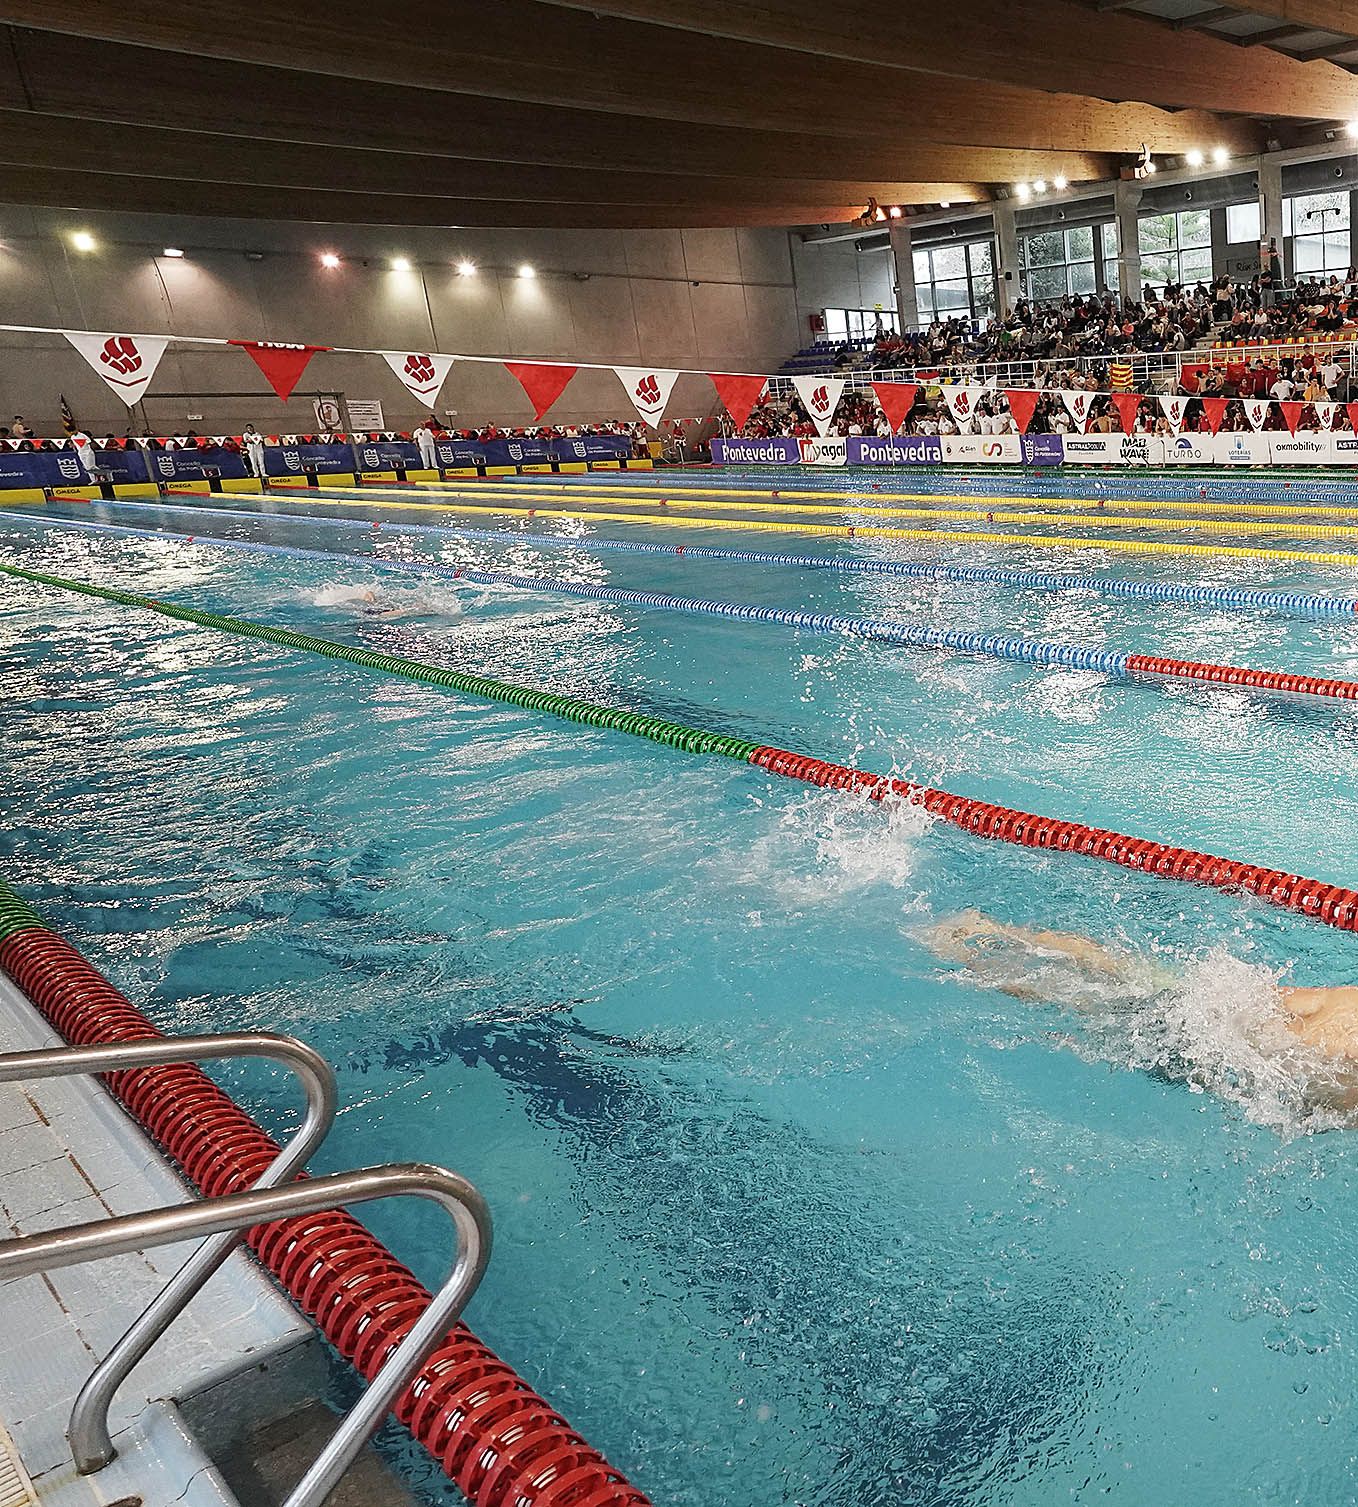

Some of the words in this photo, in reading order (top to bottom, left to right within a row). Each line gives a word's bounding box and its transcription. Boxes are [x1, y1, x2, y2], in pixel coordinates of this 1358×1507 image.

[1122, 438, 1146, 447] MAD
[722, 443, 786, 461] Pontevedra
[860, 441, 941, 461] Pontevedra
[1120, 449, 1149, 458] WAVE
[1168, 450, 1201, 458] TURBO
